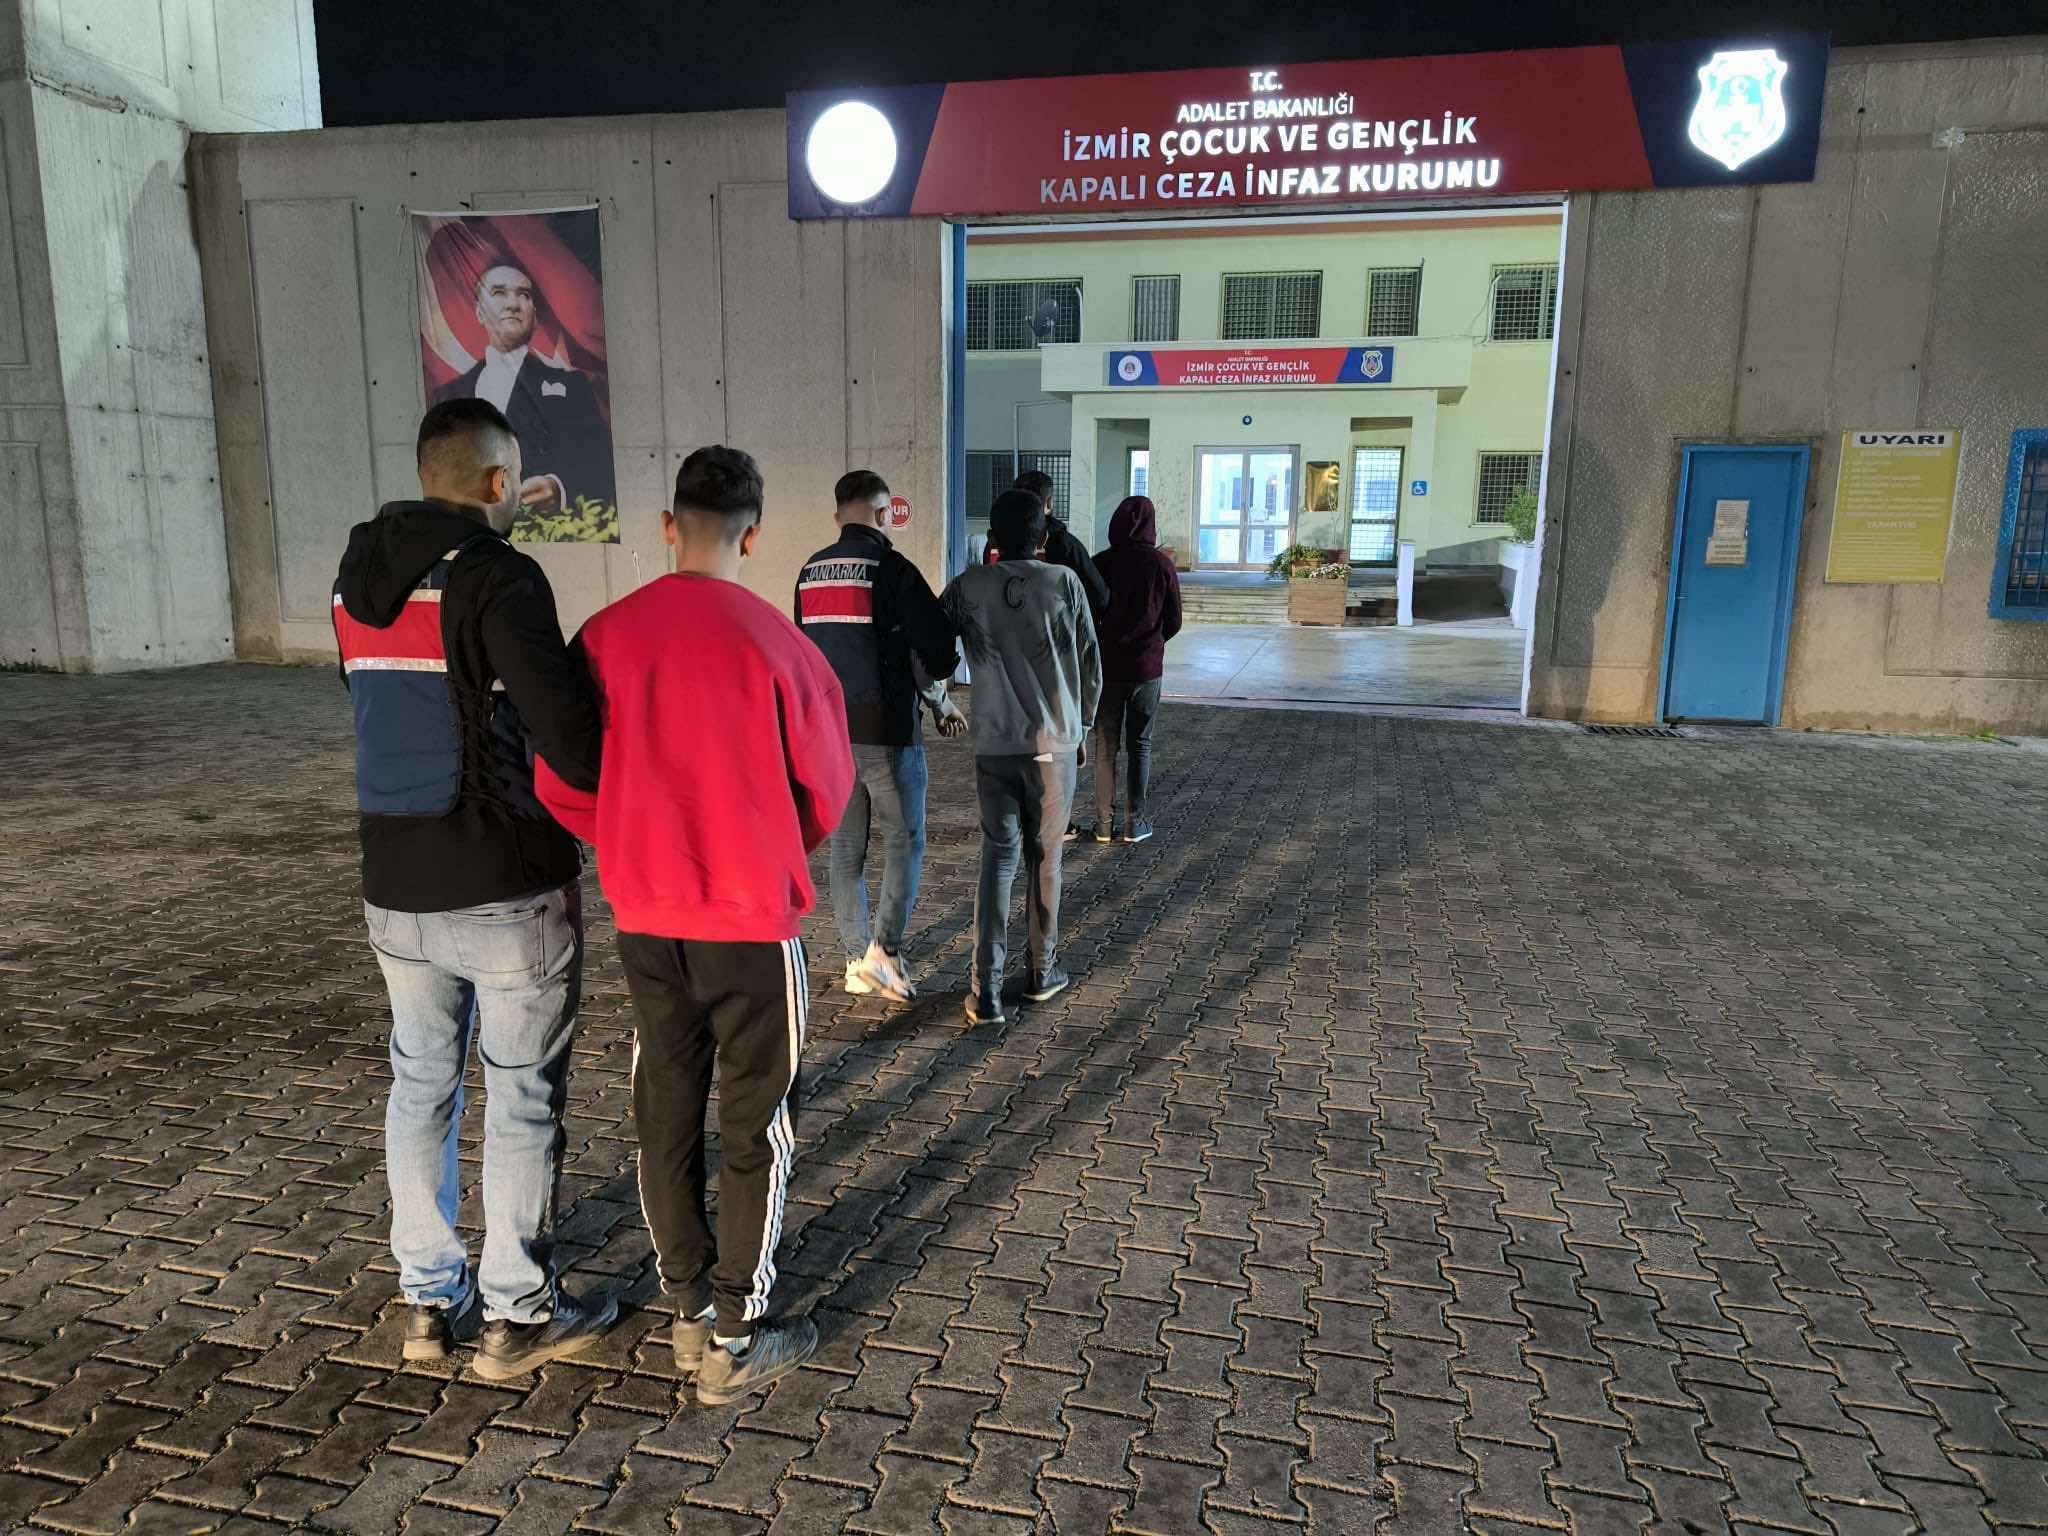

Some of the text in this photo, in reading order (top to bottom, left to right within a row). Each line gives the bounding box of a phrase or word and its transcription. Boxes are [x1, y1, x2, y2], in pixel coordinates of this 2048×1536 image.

[1249, 71, 1283, 92] T.C.
[1177, 92, 1354, 124] ADALET BAKANLIĞI
[1063, 110, 1478, 165] İZMİR ÇOCUK VE GENÇLİK
[1040, 159, 1500, 204] KAPALI CEZA İNFAZ KURUMU
[1186, 361, 1214, 372] İZMİR
[1216, 362, 1250, 374] ÇOCUK
[1252, 362, 1264, 371] VE
[1266, 359, 1310, 373] GENÇLİK
[1179, 372, 1316, 384] KAPALI CEZA İNFAZ KURUMU
[1860, 435, 1945, 445] UYARI
[893, 505, 909, 516] UR
[806, 564, 866, 582] JANDARMA
